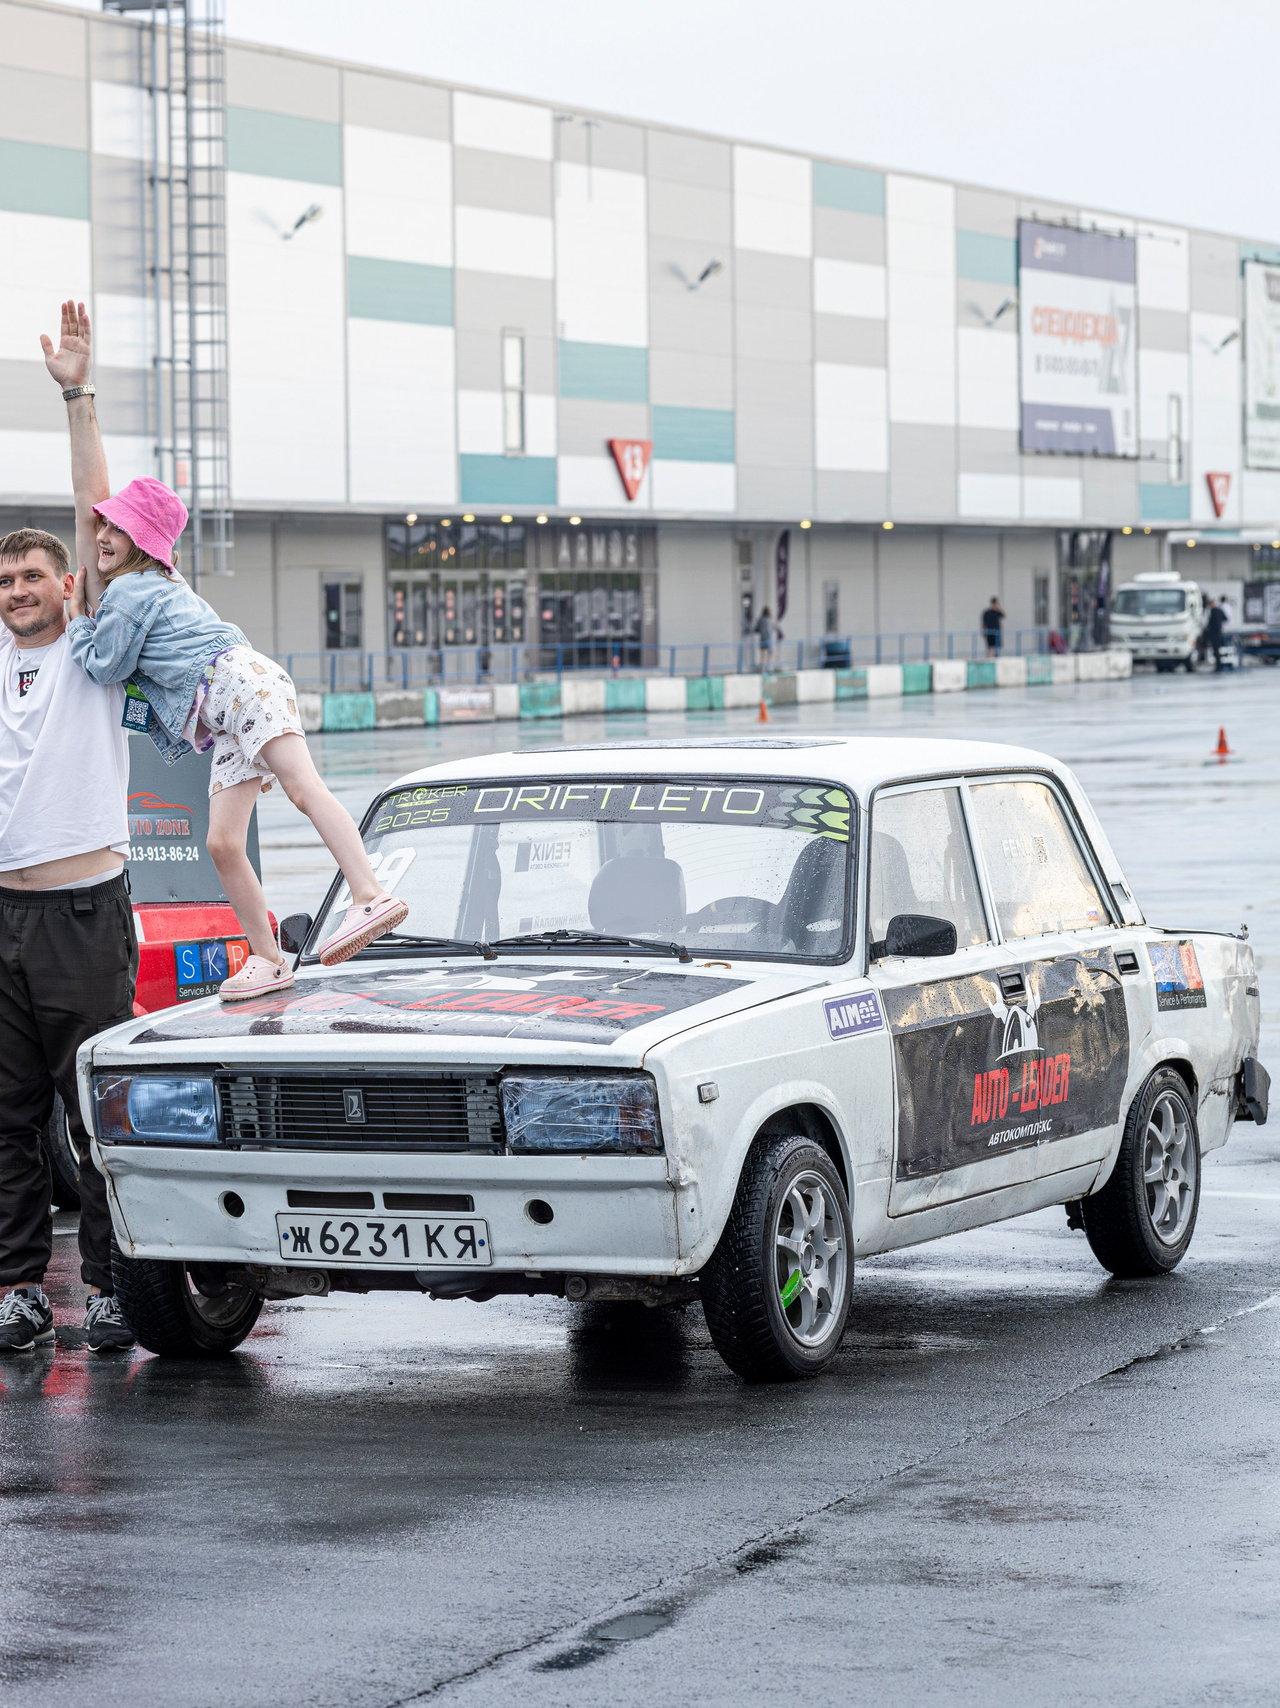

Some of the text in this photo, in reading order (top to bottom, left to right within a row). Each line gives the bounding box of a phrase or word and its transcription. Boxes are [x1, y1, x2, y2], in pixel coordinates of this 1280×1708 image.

[623, 444, 644, 480] 13
[473, 785, 765, 815] DRIFT LETO
[128, 819, 191, 835] UTO ZONE
[375, 808, 450, 832] 2025
[182, 945, 244, 979] SKR
[178, 985, 204, 998] Service
[830, 1000, 881, 1036] AIMOL
[970, 1067, 1010, 1126] AUTO
[987, 1118, 1053, 1147] АВТОКОМПЛЕКС
[319, 1220, 410, 1258] 6231
